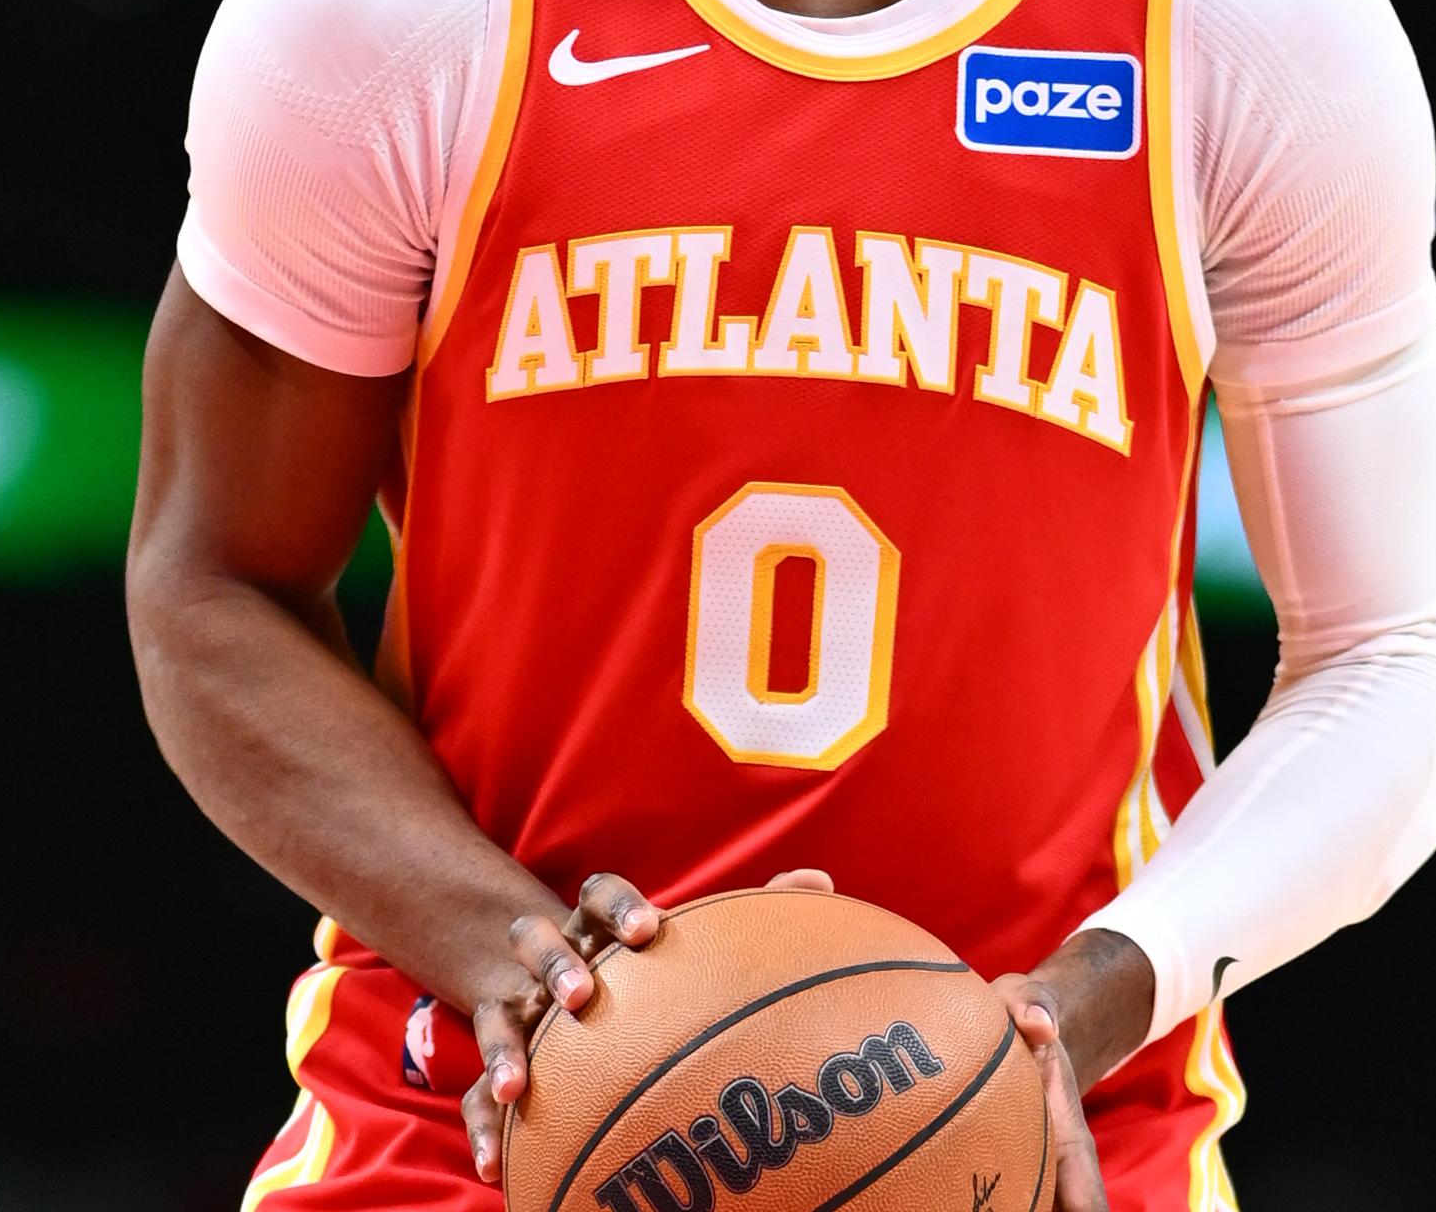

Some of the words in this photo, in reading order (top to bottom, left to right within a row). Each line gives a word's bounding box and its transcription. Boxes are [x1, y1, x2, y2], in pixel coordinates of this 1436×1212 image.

[975, 78, 1123, 123] paze
[485, 225, 1134, 457] ATLANTA
[682, 481, 902, 772] 0
[593, 1020, 946, 1212] Wilson
